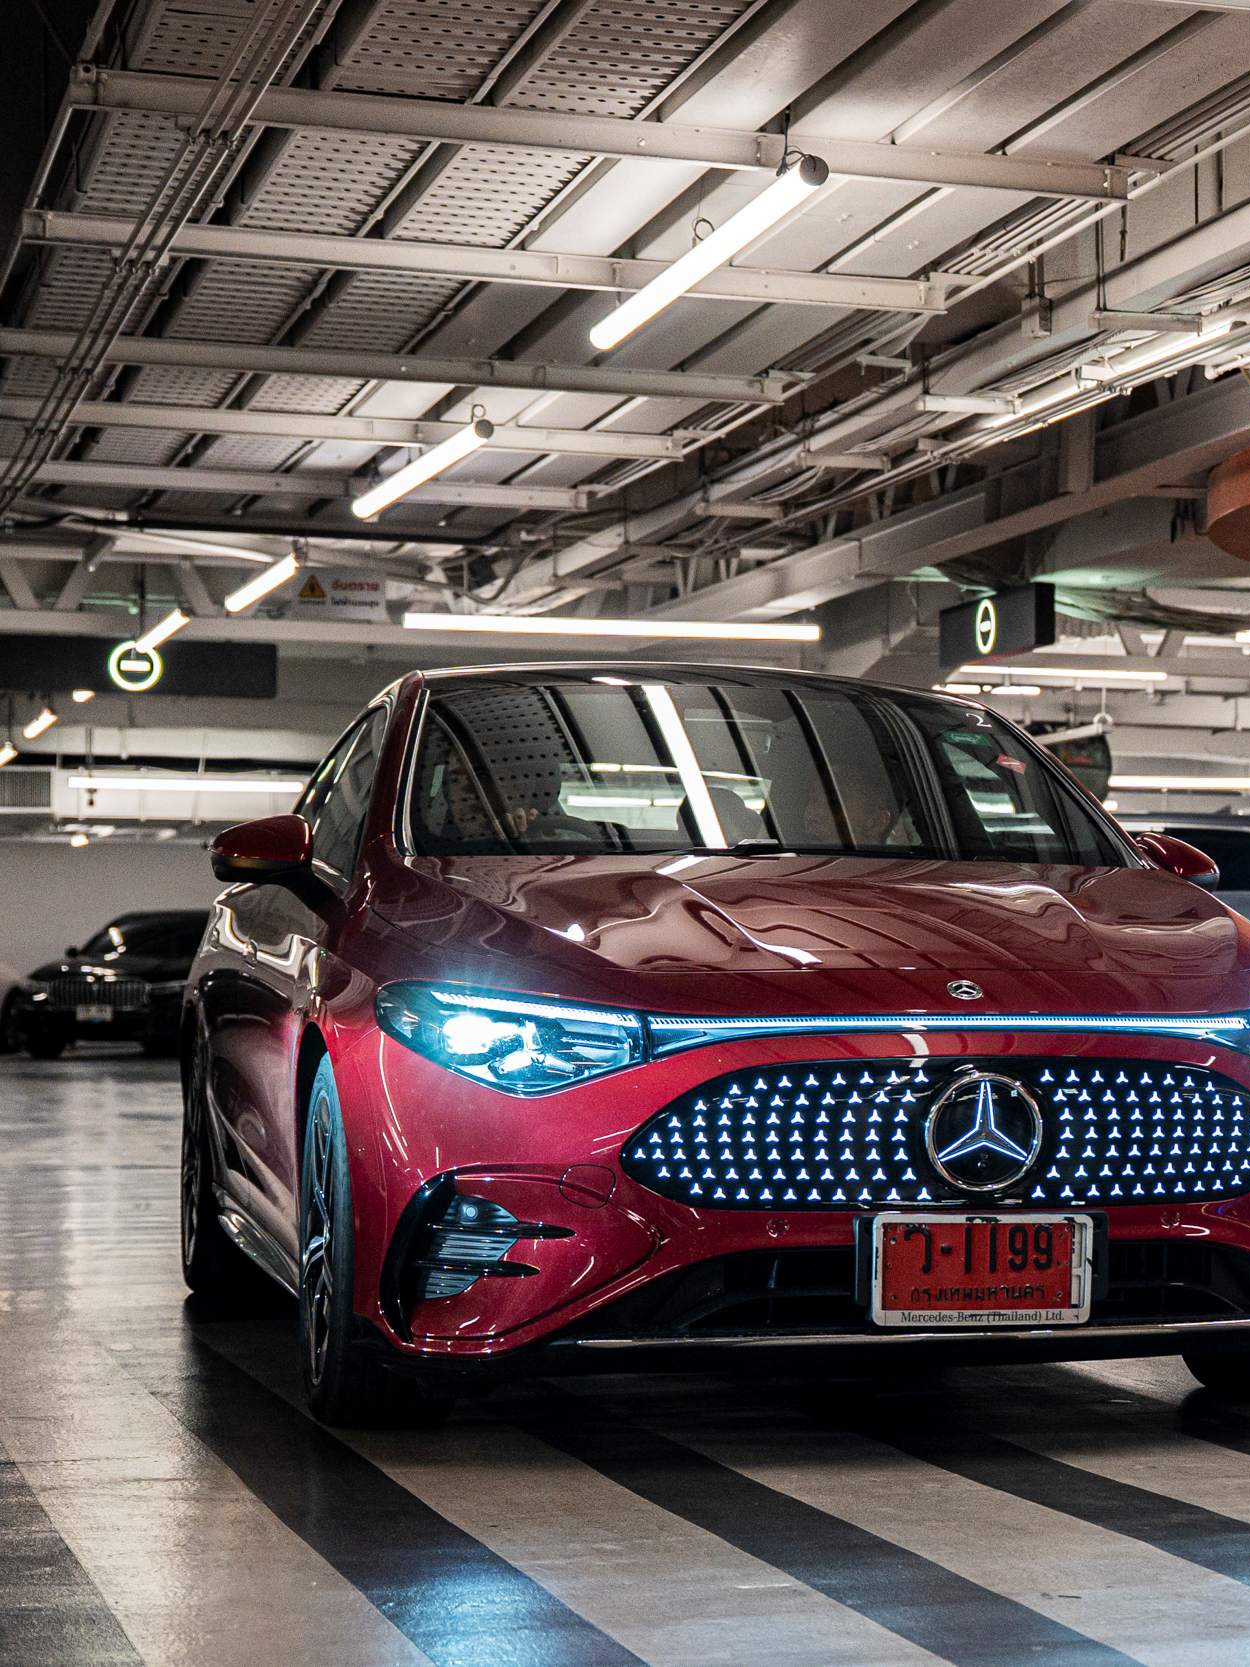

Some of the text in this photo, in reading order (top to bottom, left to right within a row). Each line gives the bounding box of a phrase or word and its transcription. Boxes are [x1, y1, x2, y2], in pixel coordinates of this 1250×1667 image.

[901, 1311, 1065, 1323] Mercedes-Benz (Thailand) Ltd.
